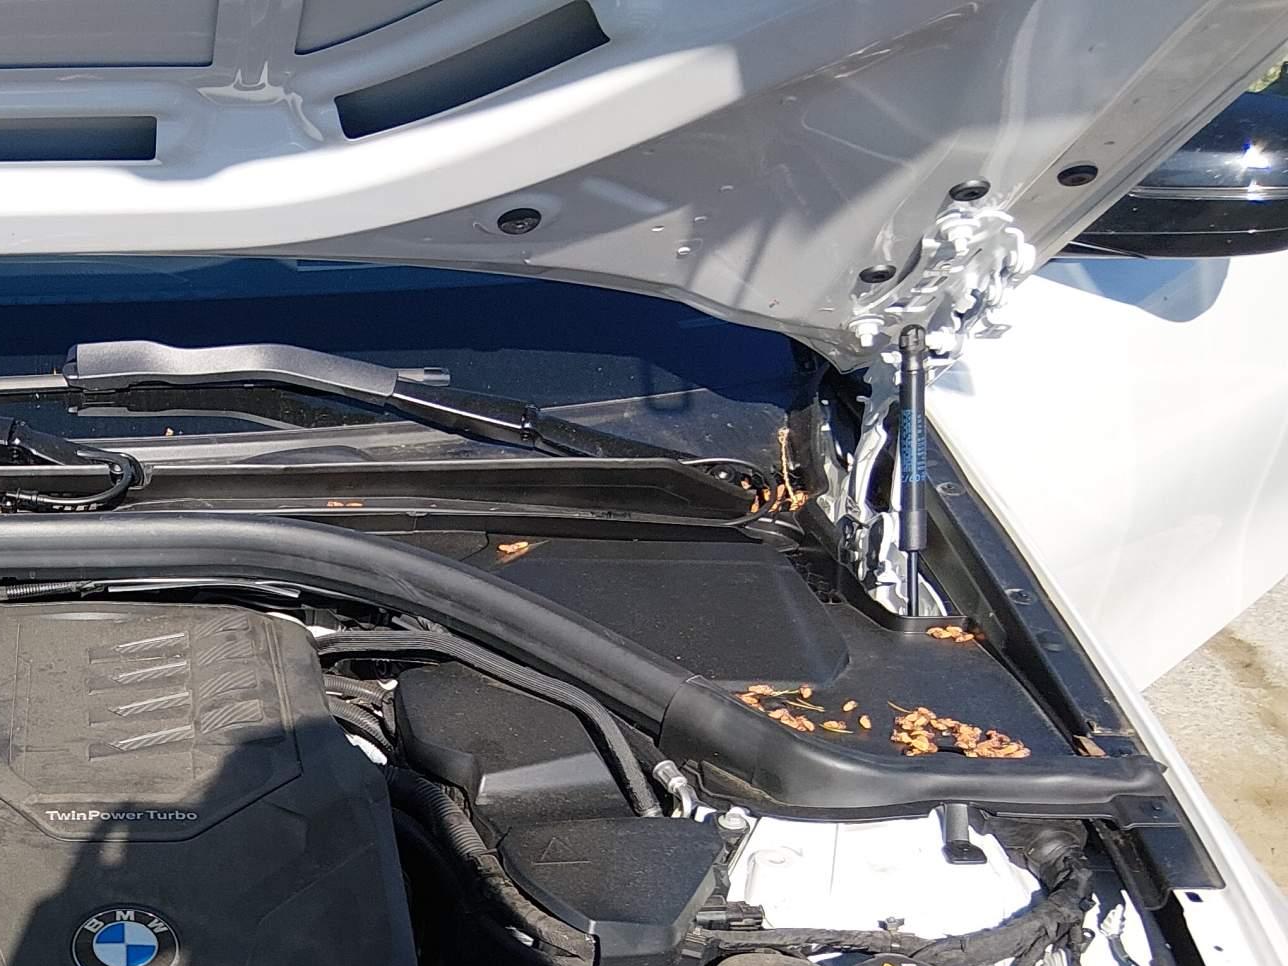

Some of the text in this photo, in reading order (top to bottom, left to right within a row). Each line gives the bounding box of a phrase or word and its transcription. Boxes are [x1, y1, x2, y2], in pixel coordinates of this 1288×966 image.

[45, 810, 198, 821] TwinPower Turbo
[84, 911, 168, 934] BMW
